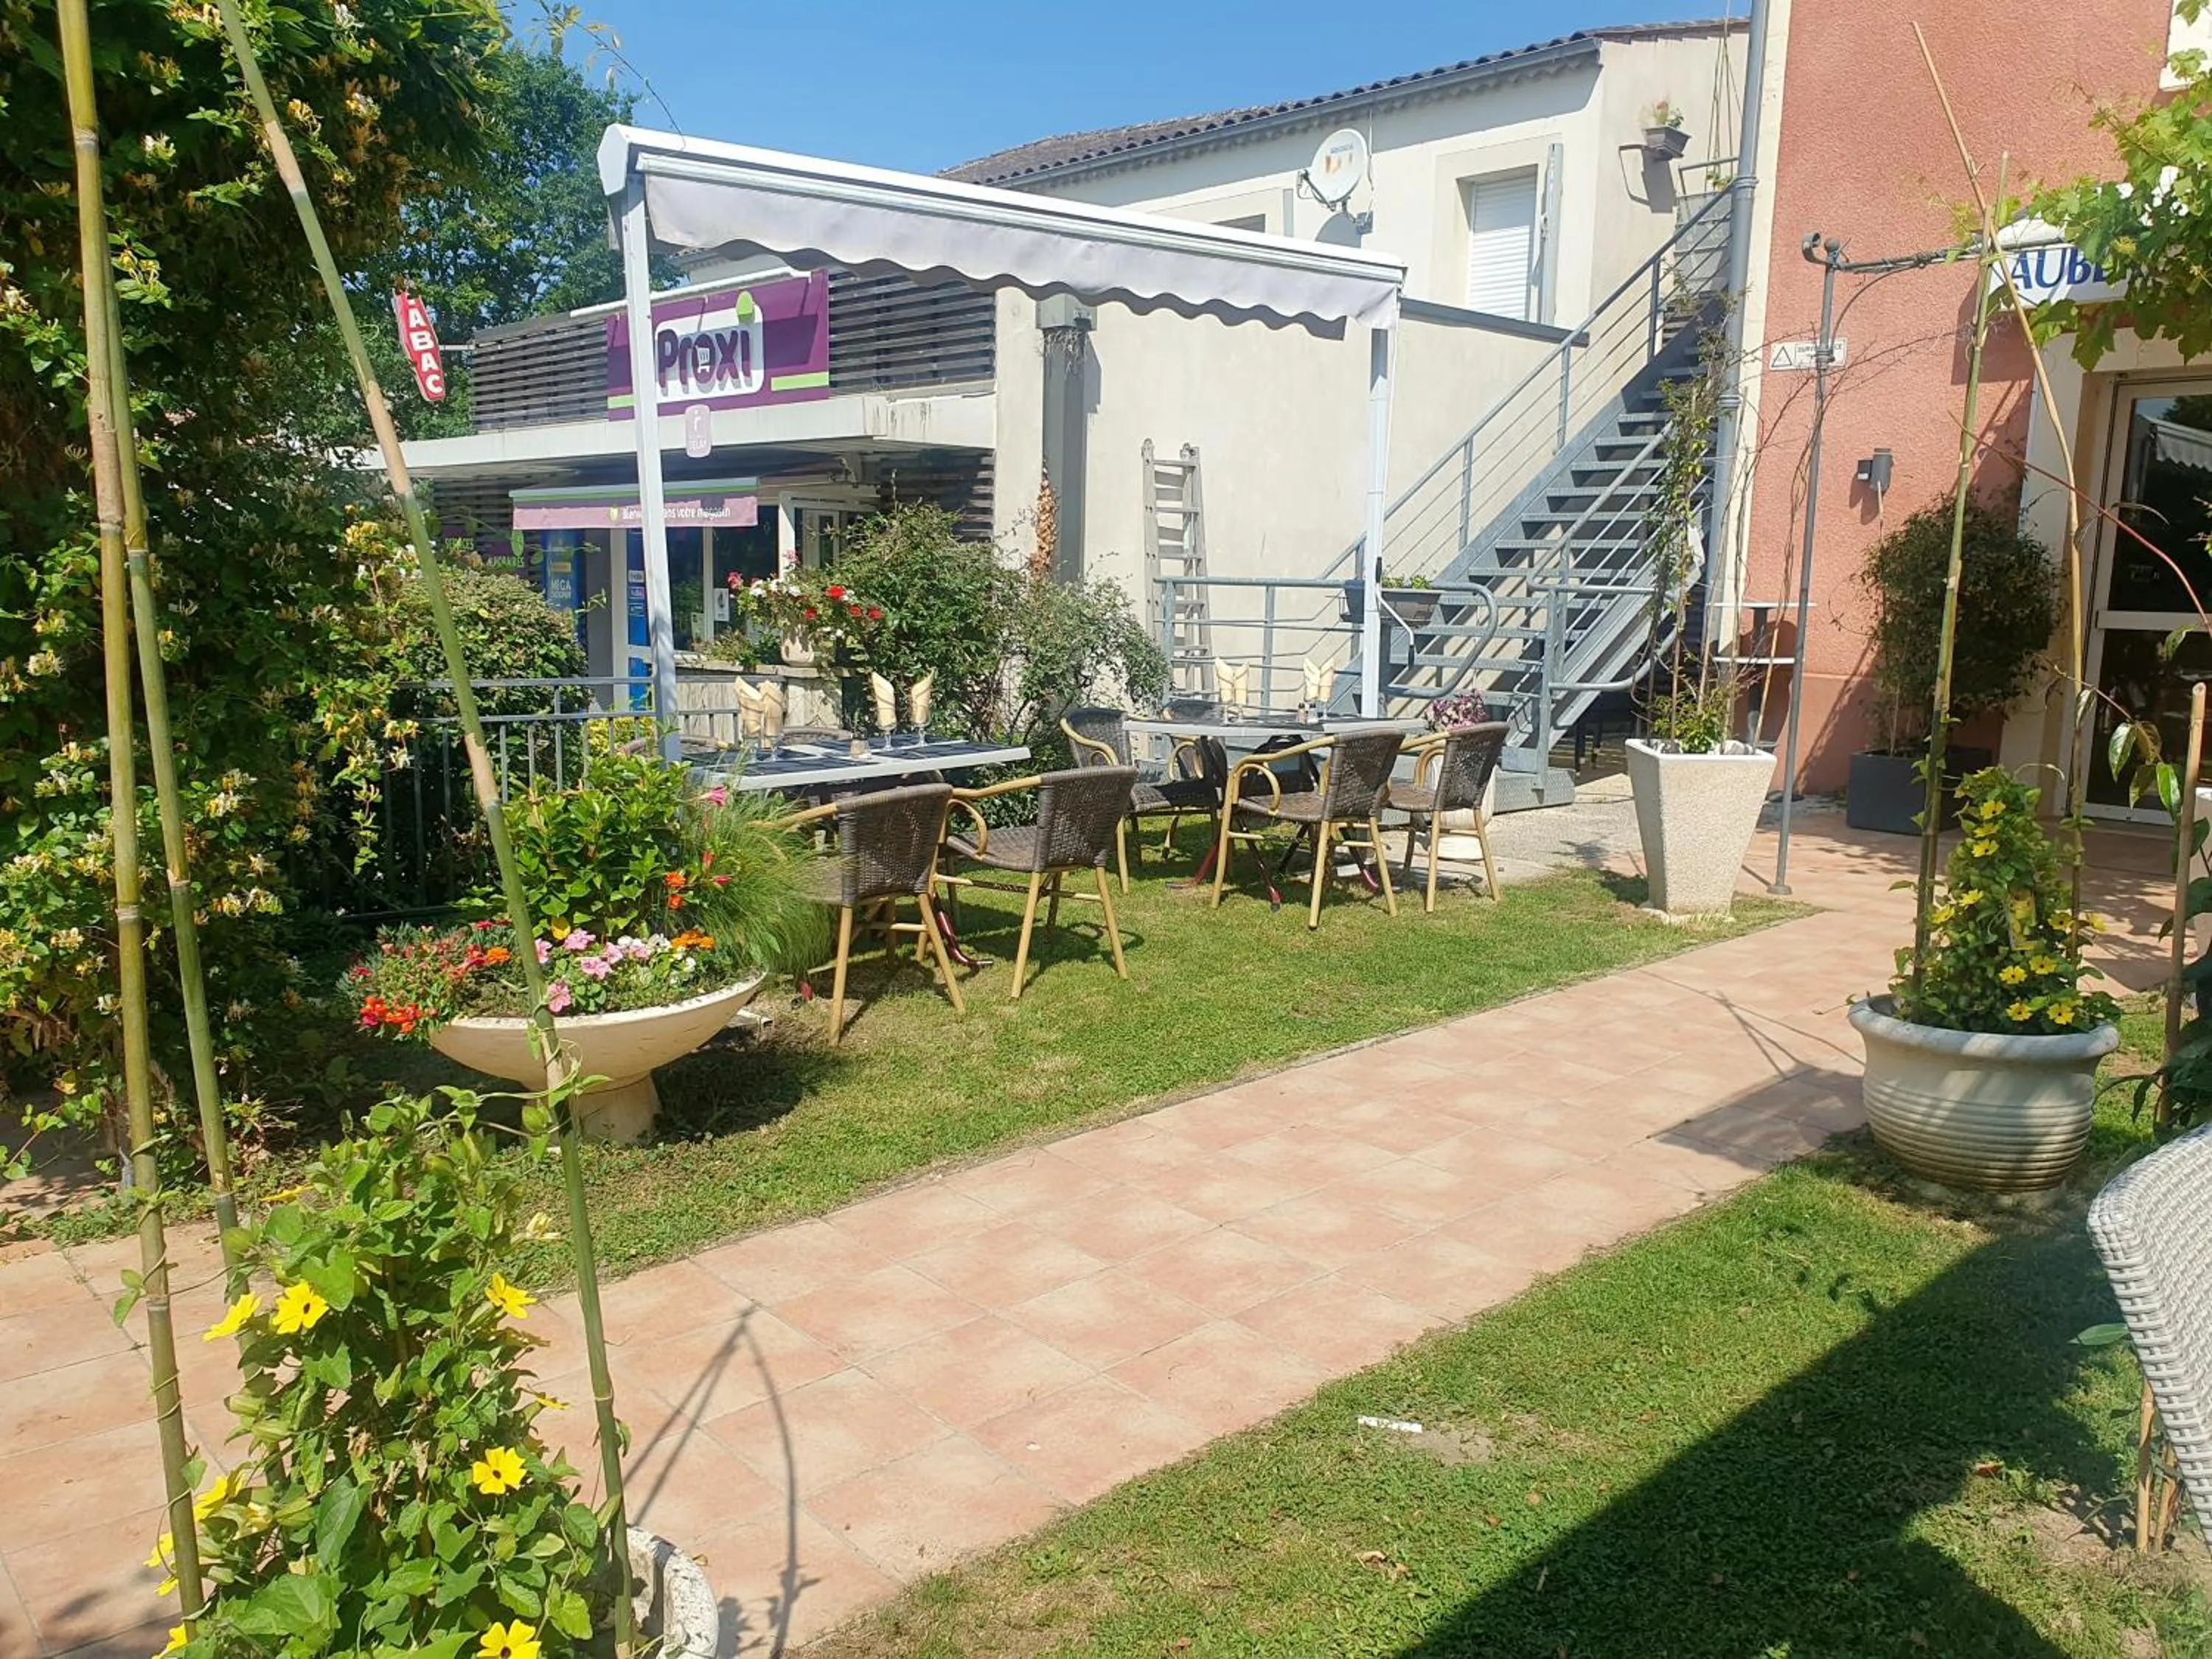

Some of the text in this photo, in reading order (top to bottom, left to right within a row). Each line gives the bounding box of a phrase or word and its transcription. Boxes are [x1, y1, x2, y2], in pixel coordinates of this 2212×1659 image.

[407, 299, 443, 394] ABAC
[677, 507, 696, 518] votre
[697, 507, 731, 521] magasin
